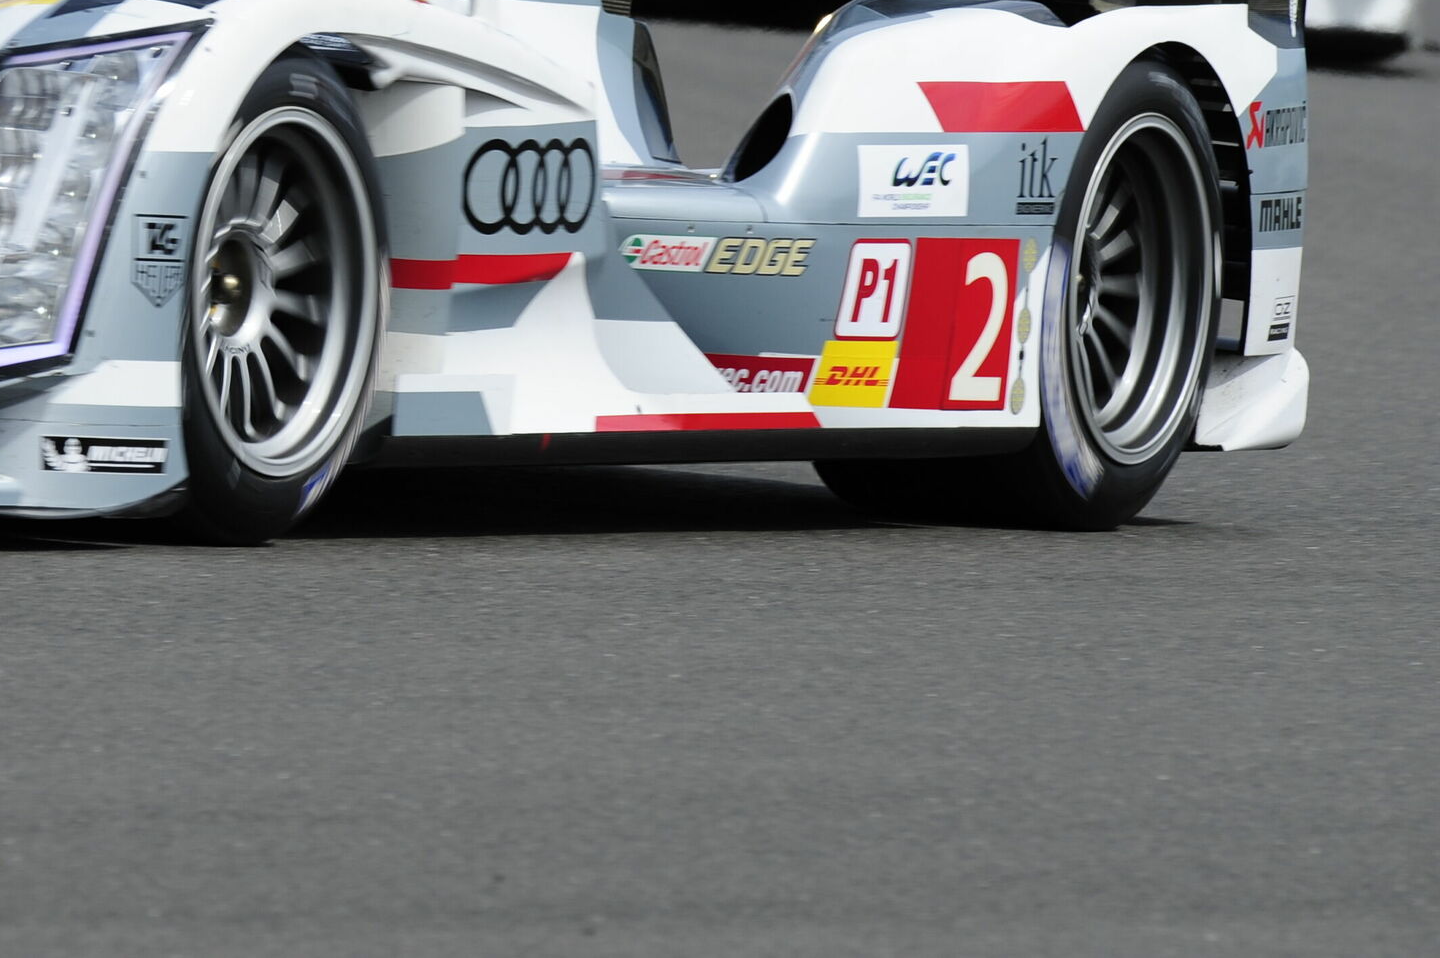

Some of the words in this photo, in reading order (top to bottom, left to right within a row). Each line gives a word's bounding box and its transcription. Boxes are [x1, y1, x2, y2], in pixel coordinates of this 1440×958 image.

[892, 151, 957, 188] WEC
[1016, 137, 1059, 199] itk
[1259, 195, 1302, 233] MAHLE
[640, 239, 710, 267] Castrol
[704, 236, 818, 277] EDGE
[849, 257, 900, 323] P1
[948, 251, 1009, 402] 2
[823, 365, 880, 386] DHL
